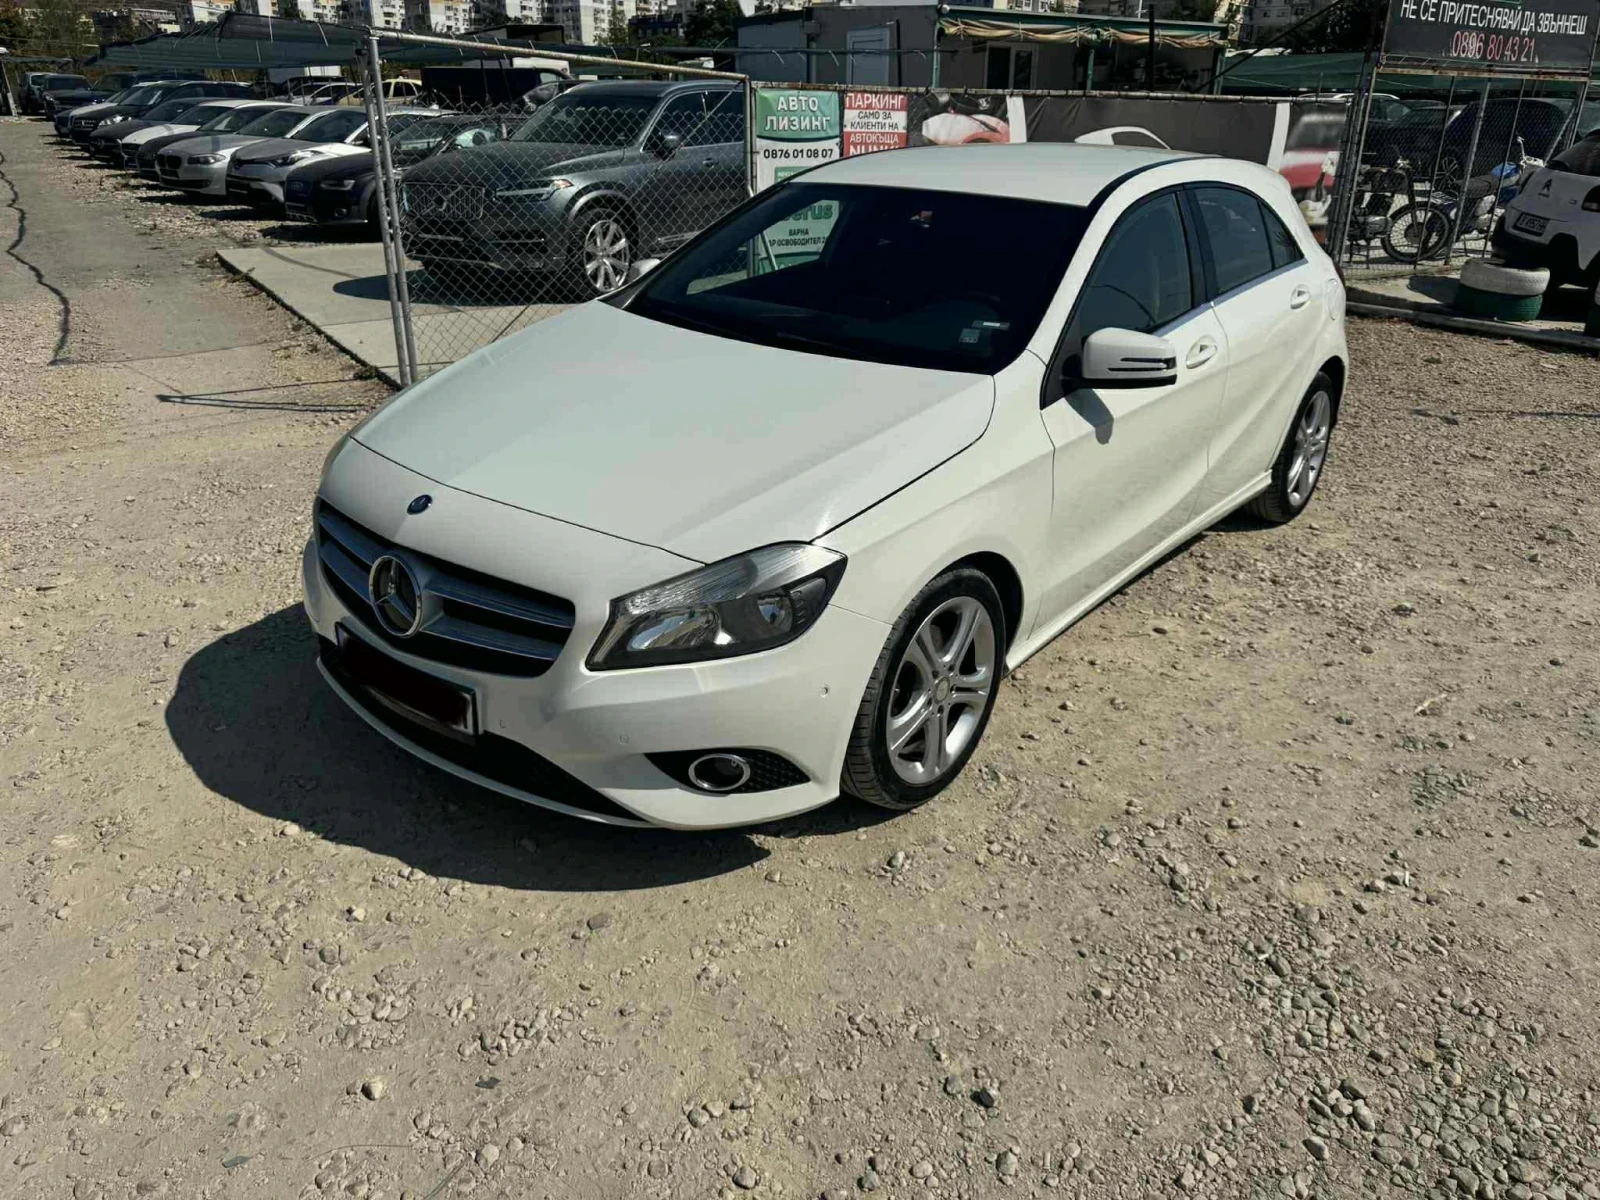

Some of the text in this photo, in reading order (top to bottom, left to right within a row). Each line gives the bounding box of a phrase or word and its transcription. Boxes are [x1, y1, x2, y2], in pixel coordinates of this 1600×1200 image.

[1400, 0, 1588, 35] НЕ СЕ ПРИТЕСНЯВАЙ ДА ЗВЪННЕШ
[1487, 34, 1503, 60] 80
[1504, 36, 1520, 61] 43
[1520, 37, 1535, 62] 21
[777, 96, 819, 111] АВТО
[845, 93, 905, 109] ПАРКИНГ
[857, 111, 880, 120] САМО
[765, 115, 831, 132] ЛИЗИНГ
[850, 121, 899, 130] КЛИЕНТИ НА
[849, 133, 899, 144] АВТОКЪЩА
[763, 148, 834, 159] 0876 01 08 07
[789, 228, 809, 236] ВАРНА
[777, 237, 821, 247] ОСВОБОДИТЕЛ
